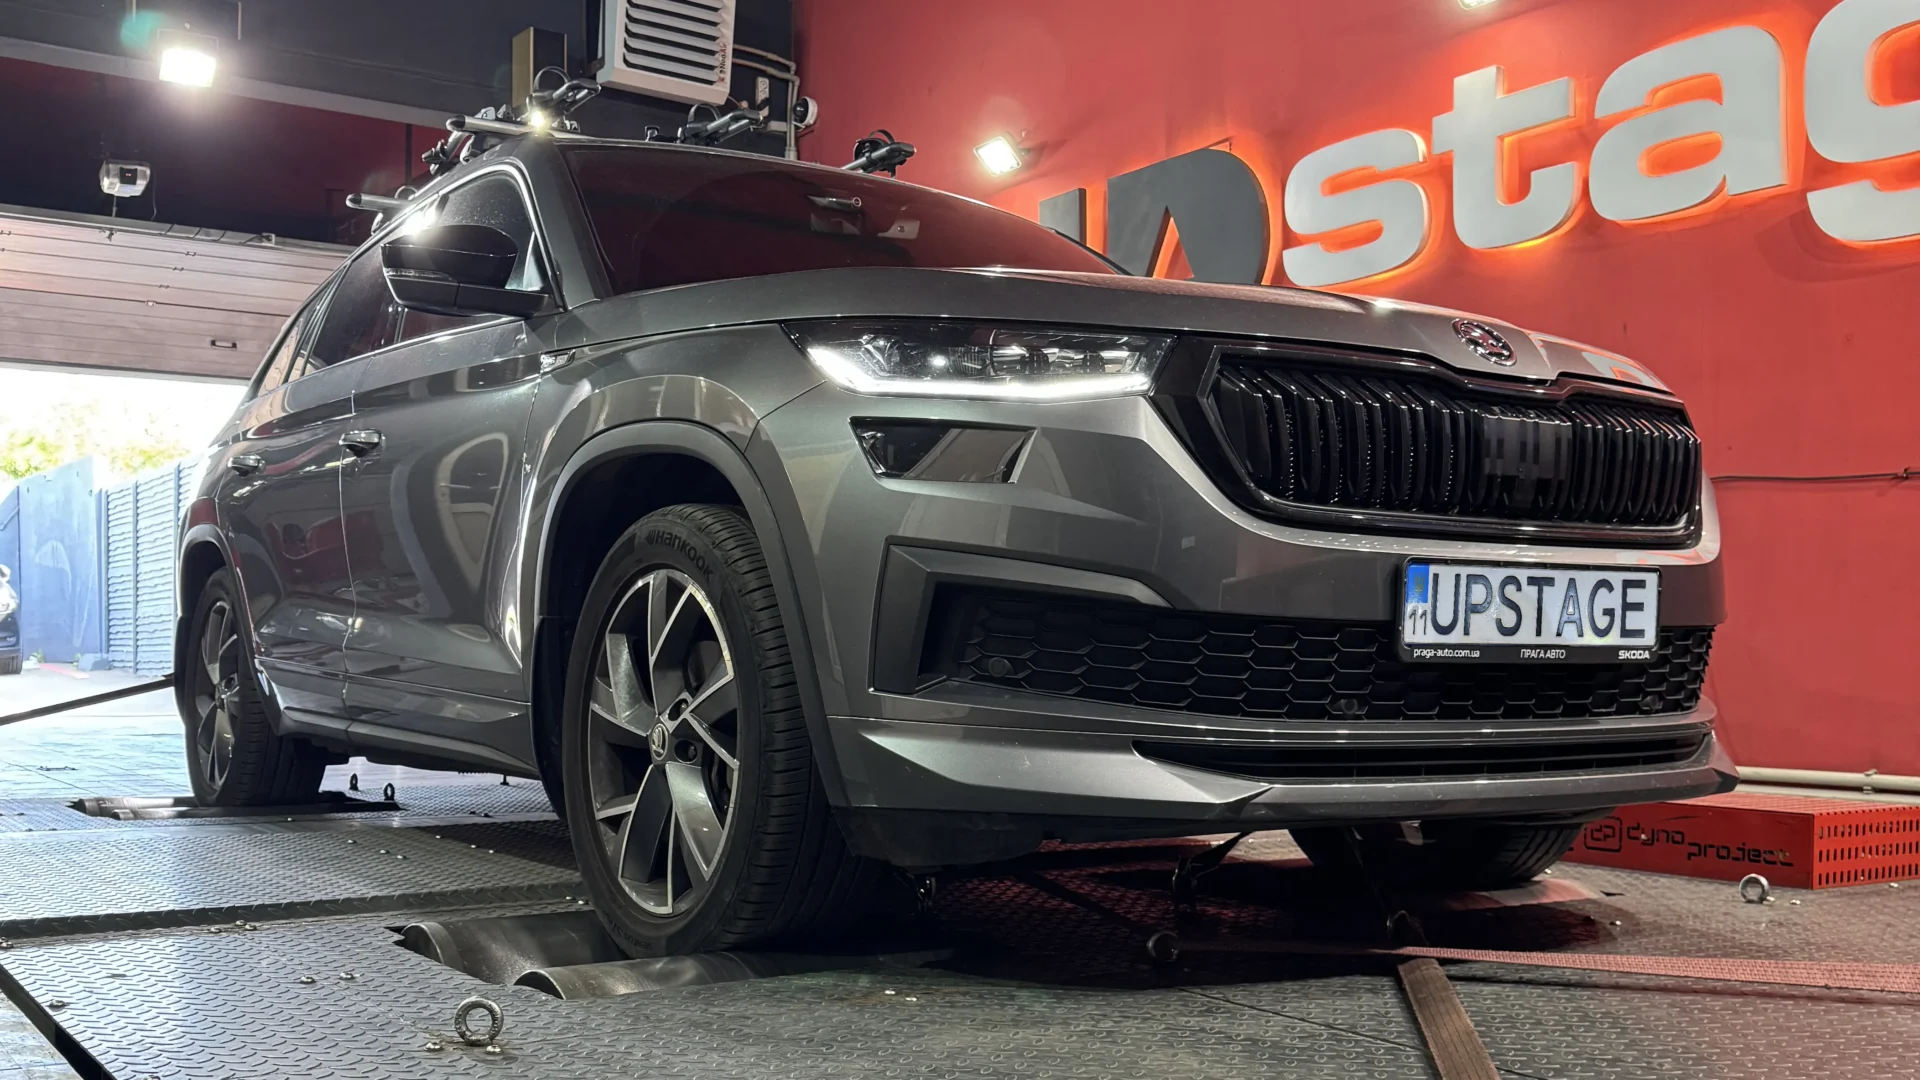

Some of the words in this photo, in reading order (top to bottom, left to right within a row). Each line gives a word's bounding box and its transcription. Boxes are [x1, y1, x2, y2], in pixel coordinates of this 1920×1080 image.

[1430, 573, 1647, 639] UPSTAGE
[1413, 648, 1480, 659] praga-auto.com.ua
[1520, 649, 1546, 659] ПРАГА
[1546, 650, 1566, 659] АВТО
[1618, 650, 1650, 660] SKODA
[1626, 823, 1685, 846] dyno
[1687, 842, 1795, 868] project
